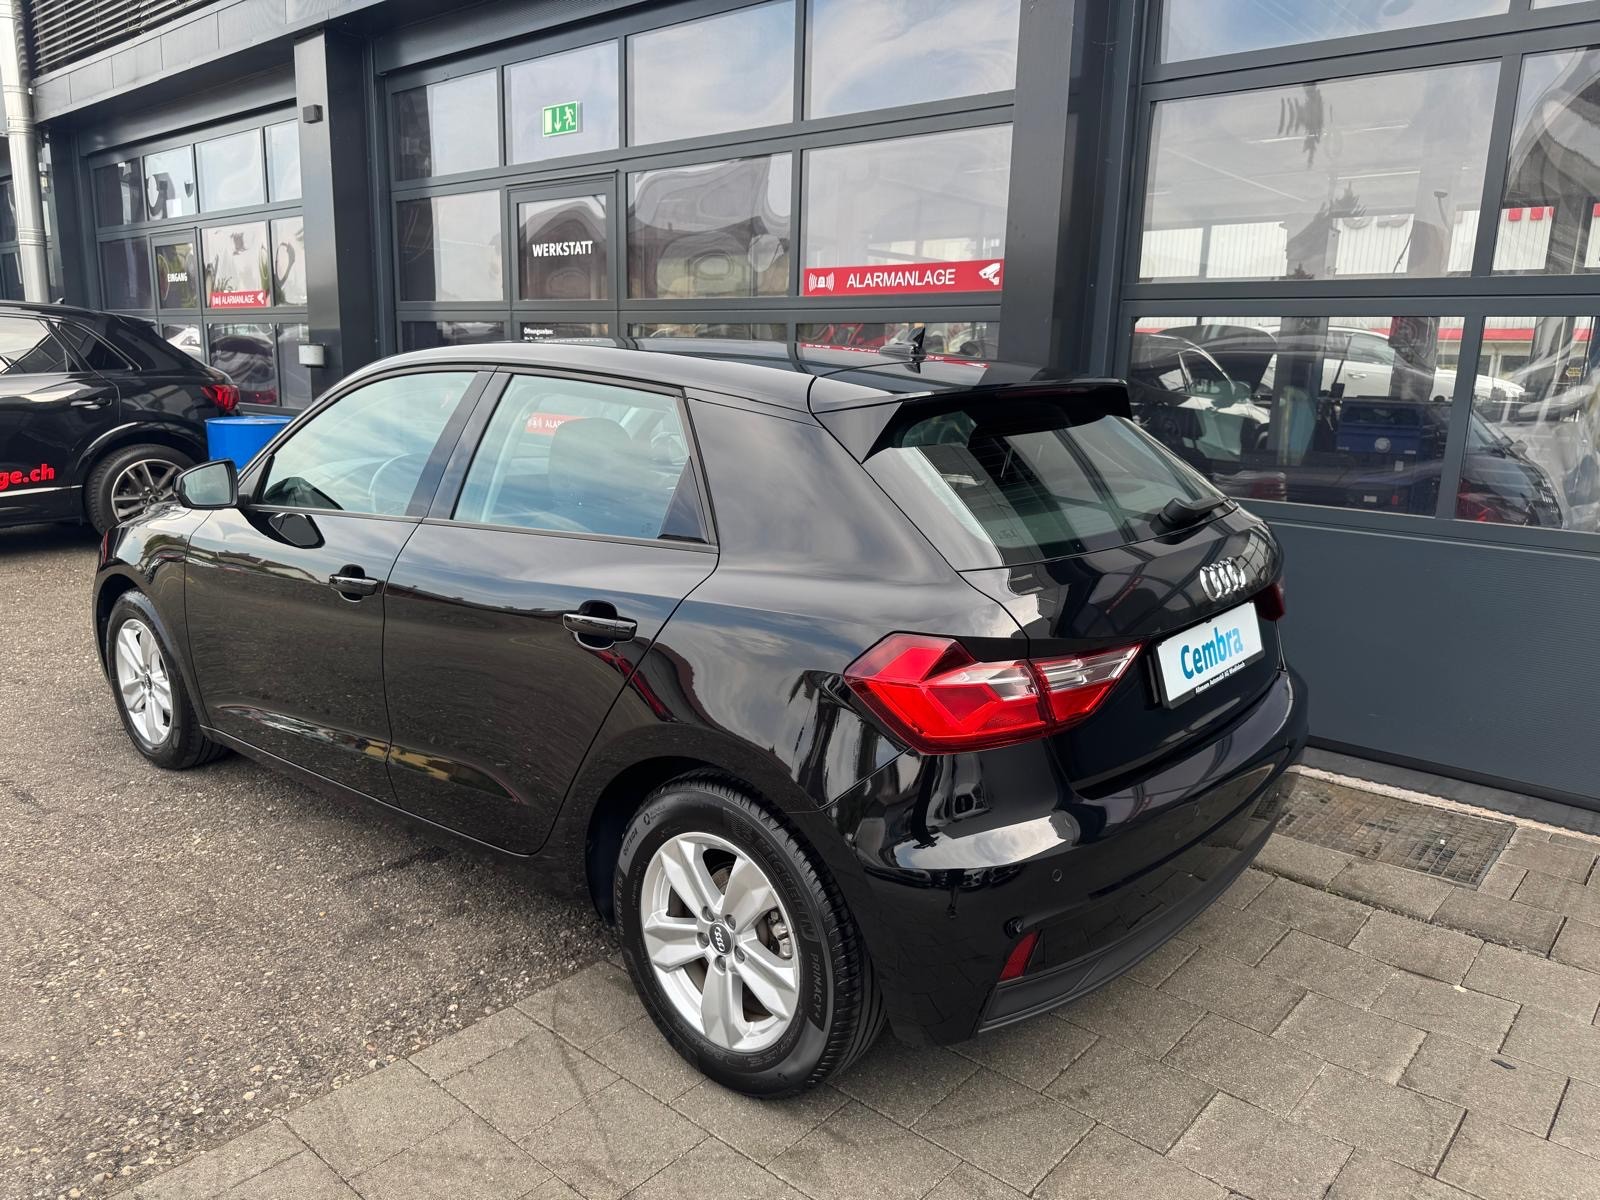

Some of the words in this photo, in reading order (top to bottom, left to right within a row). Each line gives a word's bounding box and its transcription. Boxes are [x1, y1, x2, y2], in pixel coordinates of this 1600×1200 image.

[532, 240, 593, 257] WERKSTATT
[847, 268, 956, 288] ALARMANLAGE
[221, 294, 255, 305] ALARMANLAGE
[1180, 626, 1243, 680] Cembra
[809, 952, 822, 1012] PRIMACY
